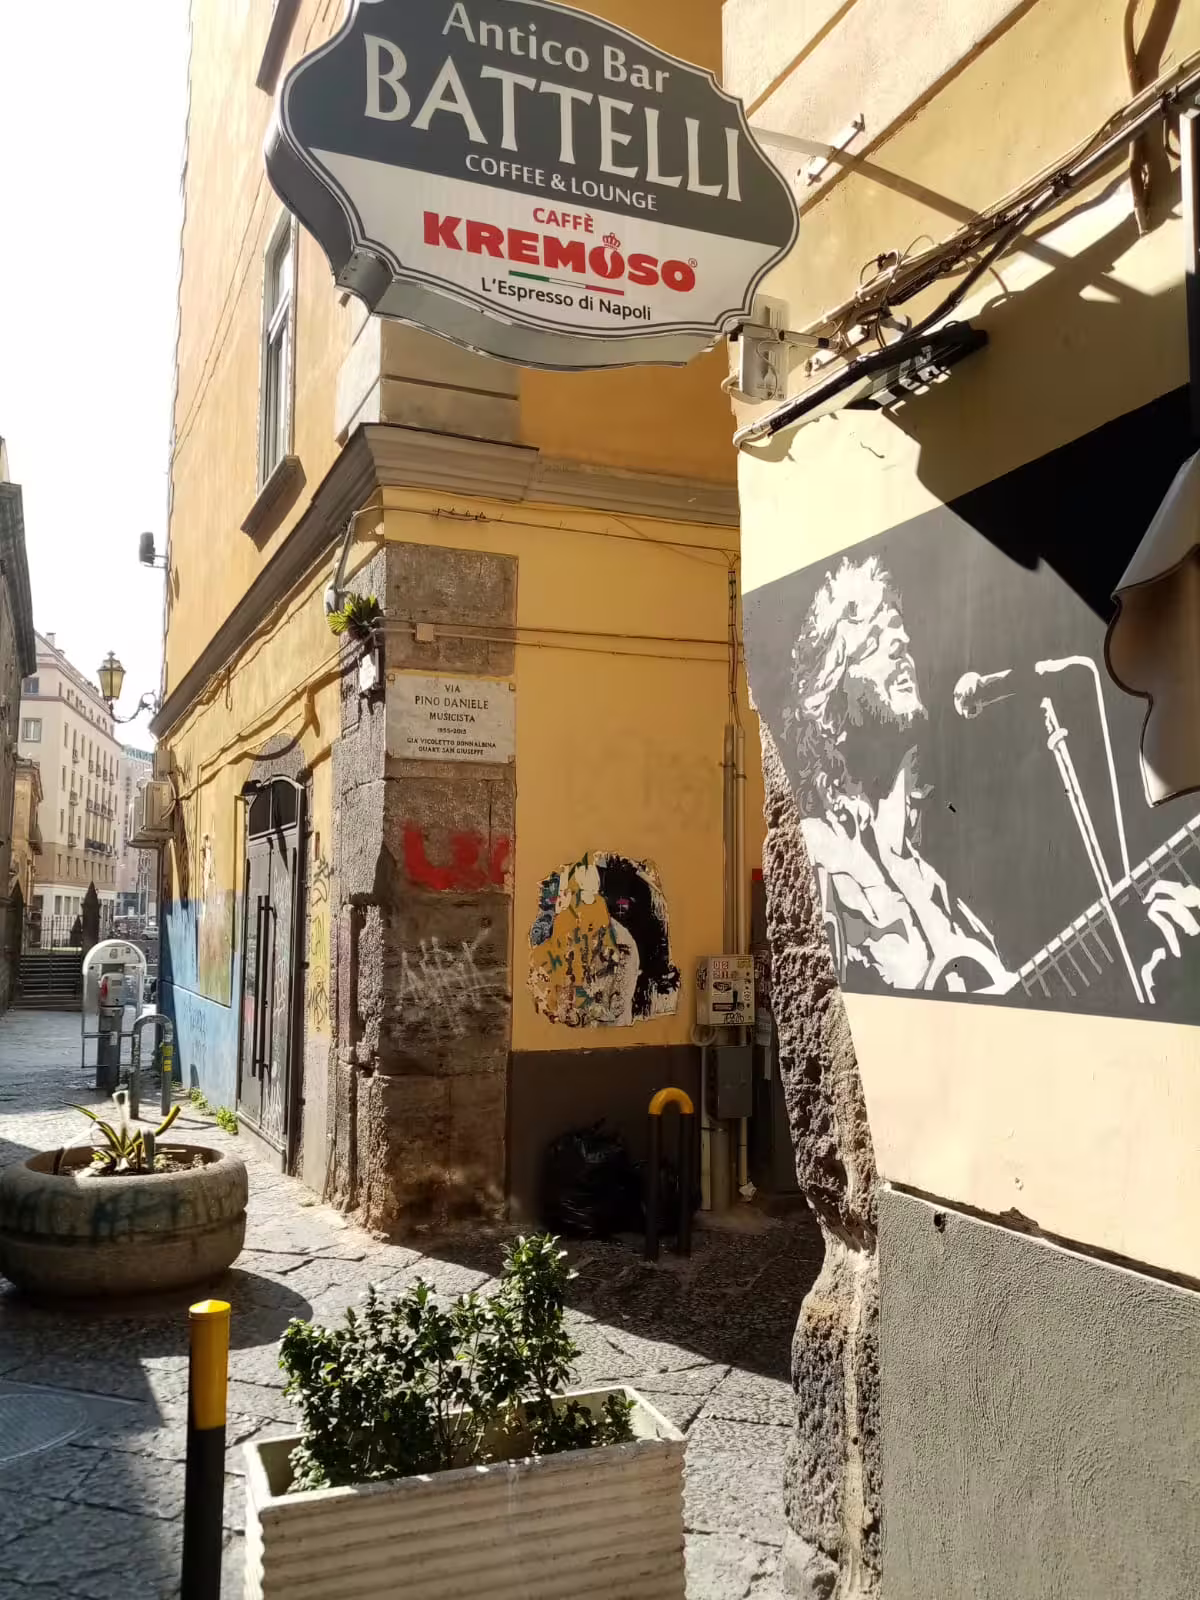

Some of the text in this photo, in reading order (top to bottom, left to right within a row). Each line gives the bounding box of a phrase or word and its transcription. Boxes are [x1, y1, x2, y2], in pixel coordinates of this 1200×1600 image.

[441, 2, 670, 94] Antico Bar
[363, 33, 743, 202] BATTELLI
[465, 153, 658, 211] COFFEE & LOUNGE
[533, 207, 595, 234] CAFFÈ
[423, 210, 696, 293] KREMOSO
[481, 277, 652, 322] L'Espresso di Napoli
[445, 684, 461, 693] VIA
[415, 695, 489, 710] PINO DANIELE
[429, 712, 476, 723] MUSICISTA
[420, 738, 455, 746] VICOLETTO
[456, 748, 484, 756] GIUSEPPE
